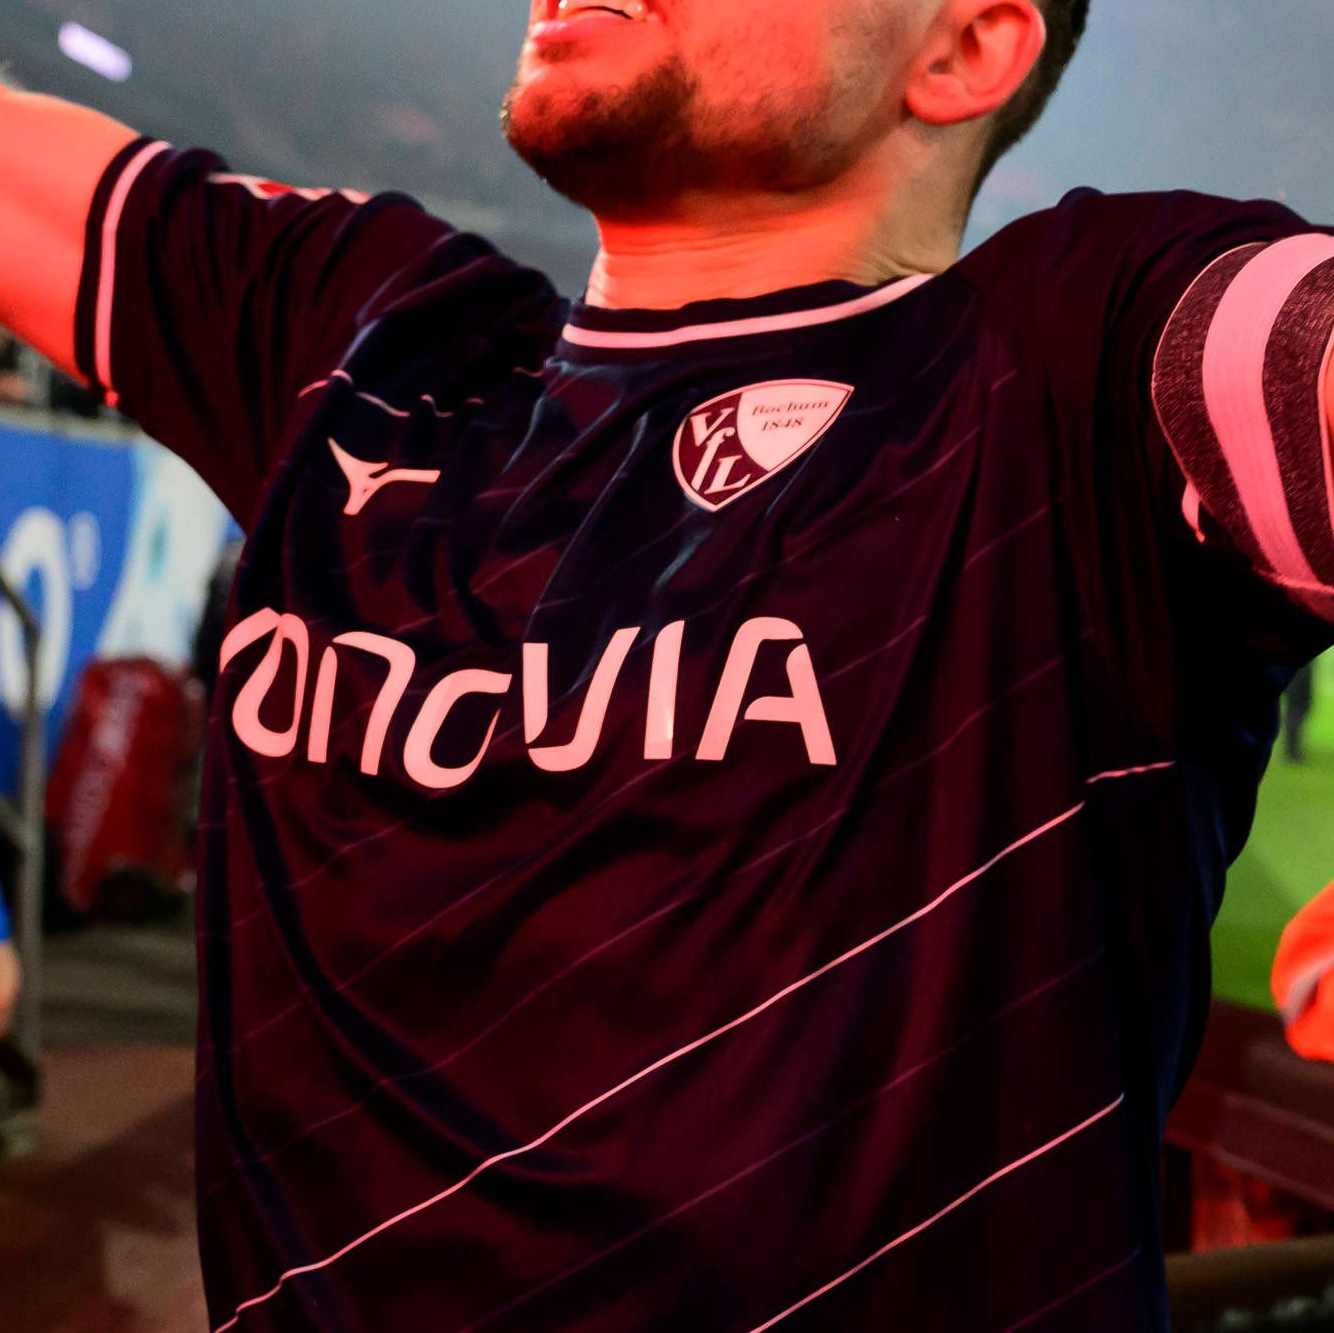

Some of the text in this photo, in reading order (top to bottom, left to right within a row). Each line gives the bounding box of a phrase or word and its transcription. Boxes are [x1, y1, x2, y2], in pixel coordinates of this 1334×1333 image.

[751, 400, 829, 416] Bochum
[761, 416, 804, 432] 1848
[690, 406, 752, 495] VfL
